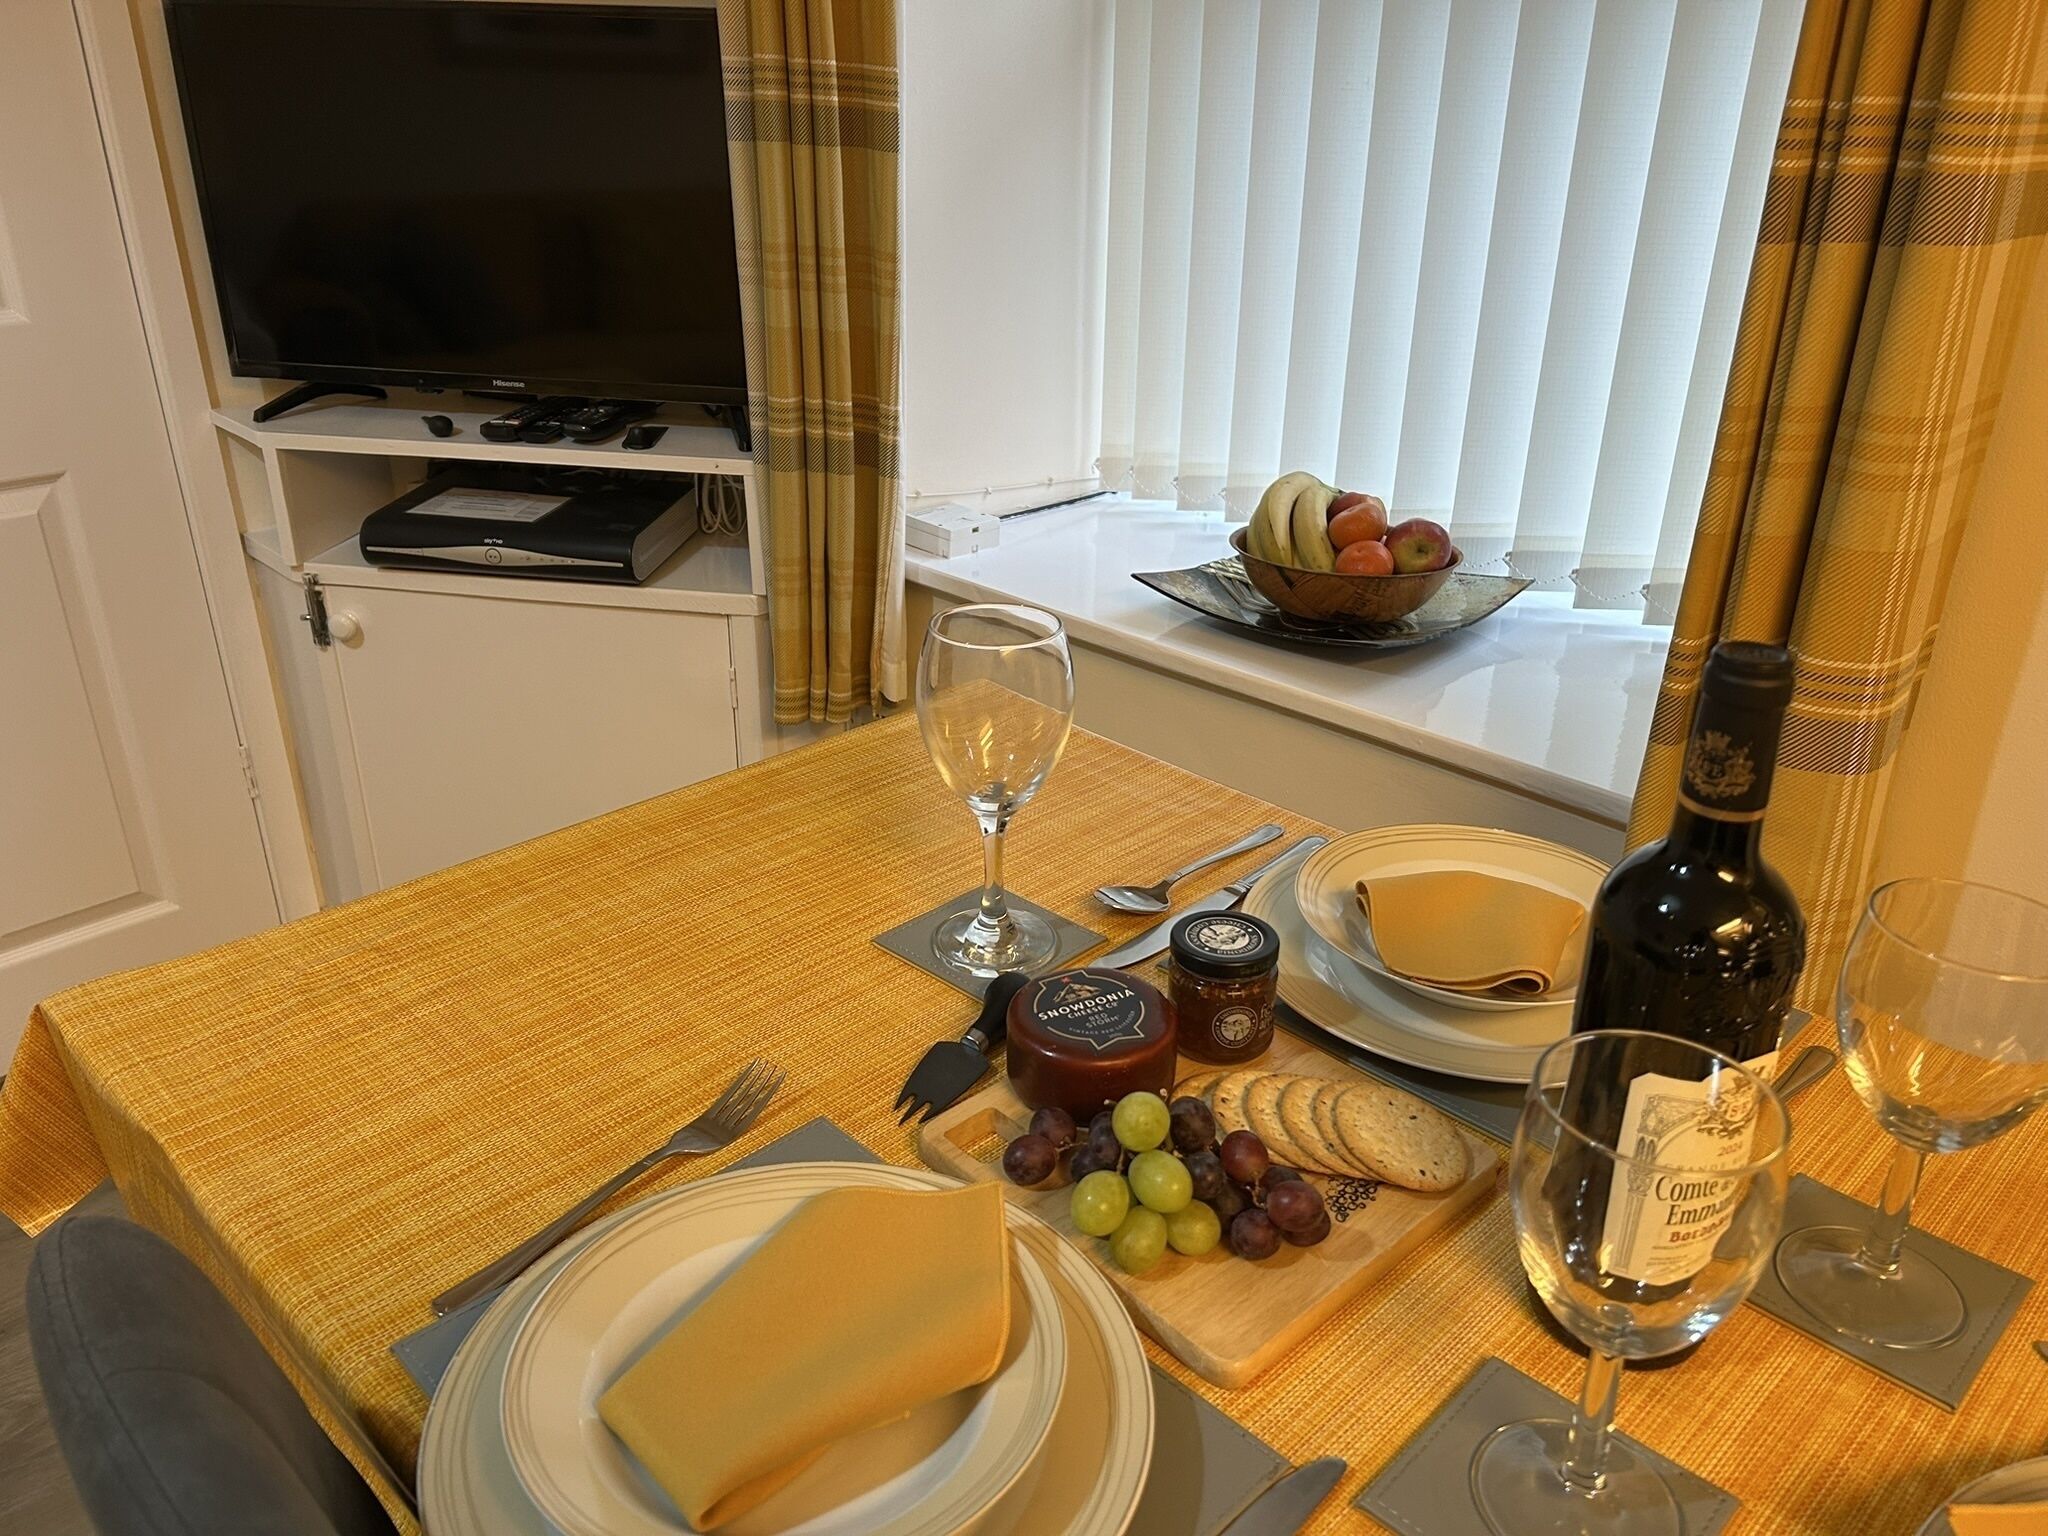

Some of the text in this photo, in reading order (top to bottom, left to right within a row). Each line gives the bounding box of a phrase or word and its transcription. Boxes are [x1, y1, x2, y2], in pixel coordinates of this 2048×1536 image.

[492, 379, 525, 388] Hisense
[1038, 988, 1135, 1021] SNOWDONIA
[1067, 1004, 1104, 1019] CHEESE
[1085, 1015, 1120, 1028] STORM
[1088, 1012, 1108, 1021] RED
[1655, 1175, 1719, 1202] Comte
